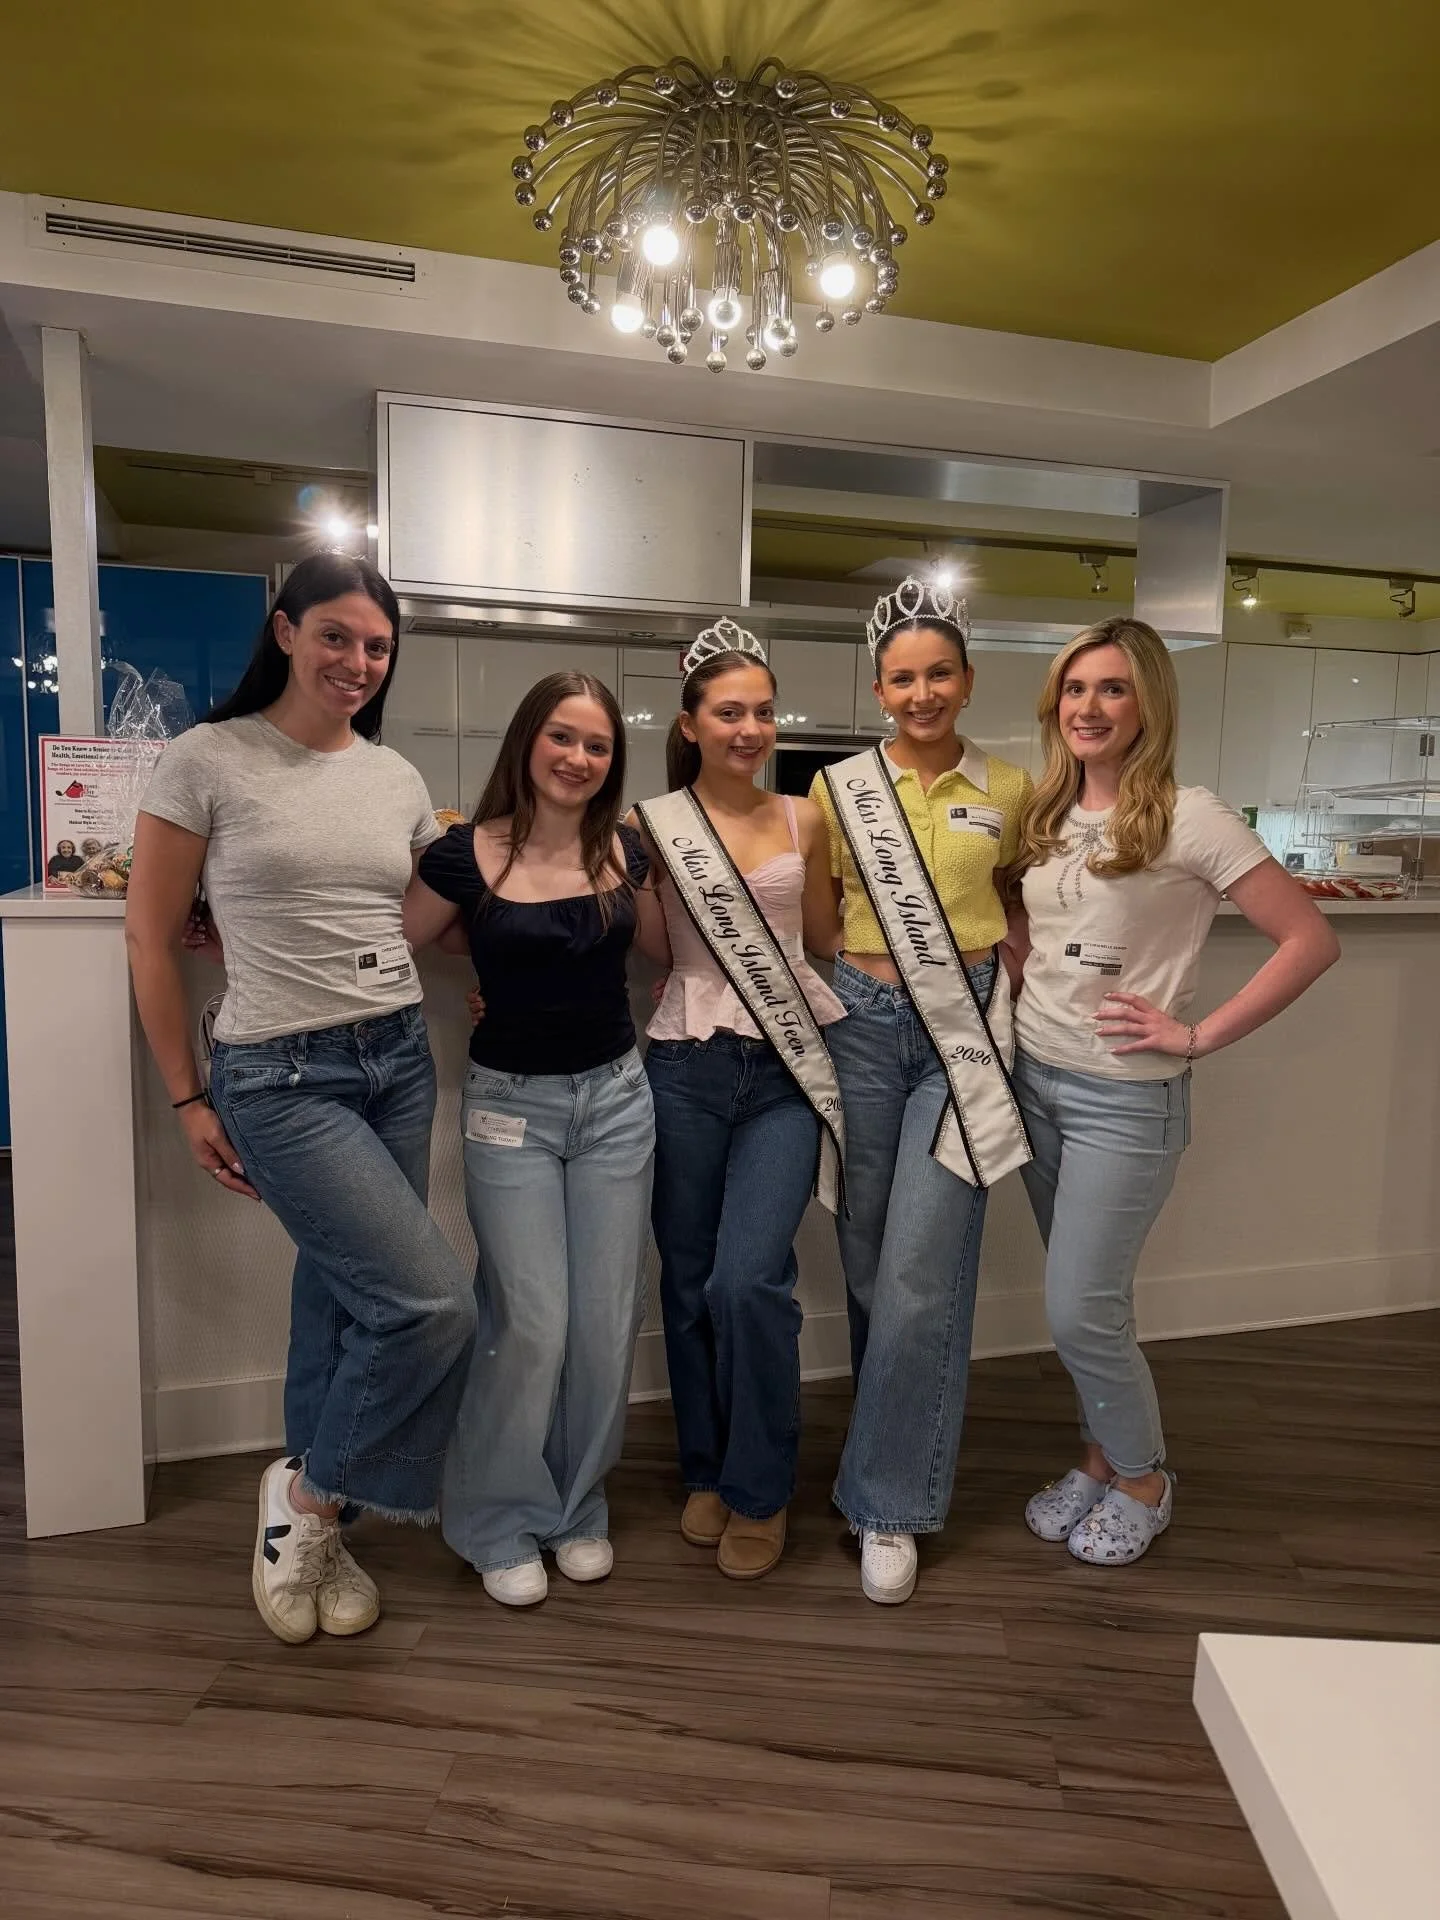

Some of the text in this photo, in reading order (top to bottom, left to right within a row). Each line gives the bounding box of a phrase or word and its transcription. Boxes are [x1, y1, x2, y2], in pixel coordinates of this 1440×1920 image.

[672, 837, 806, 1058] Miss Long Island Teen
[847, 779, 947, 967] Miss Long Island
[951, 1045, 993, 1066] 2026
